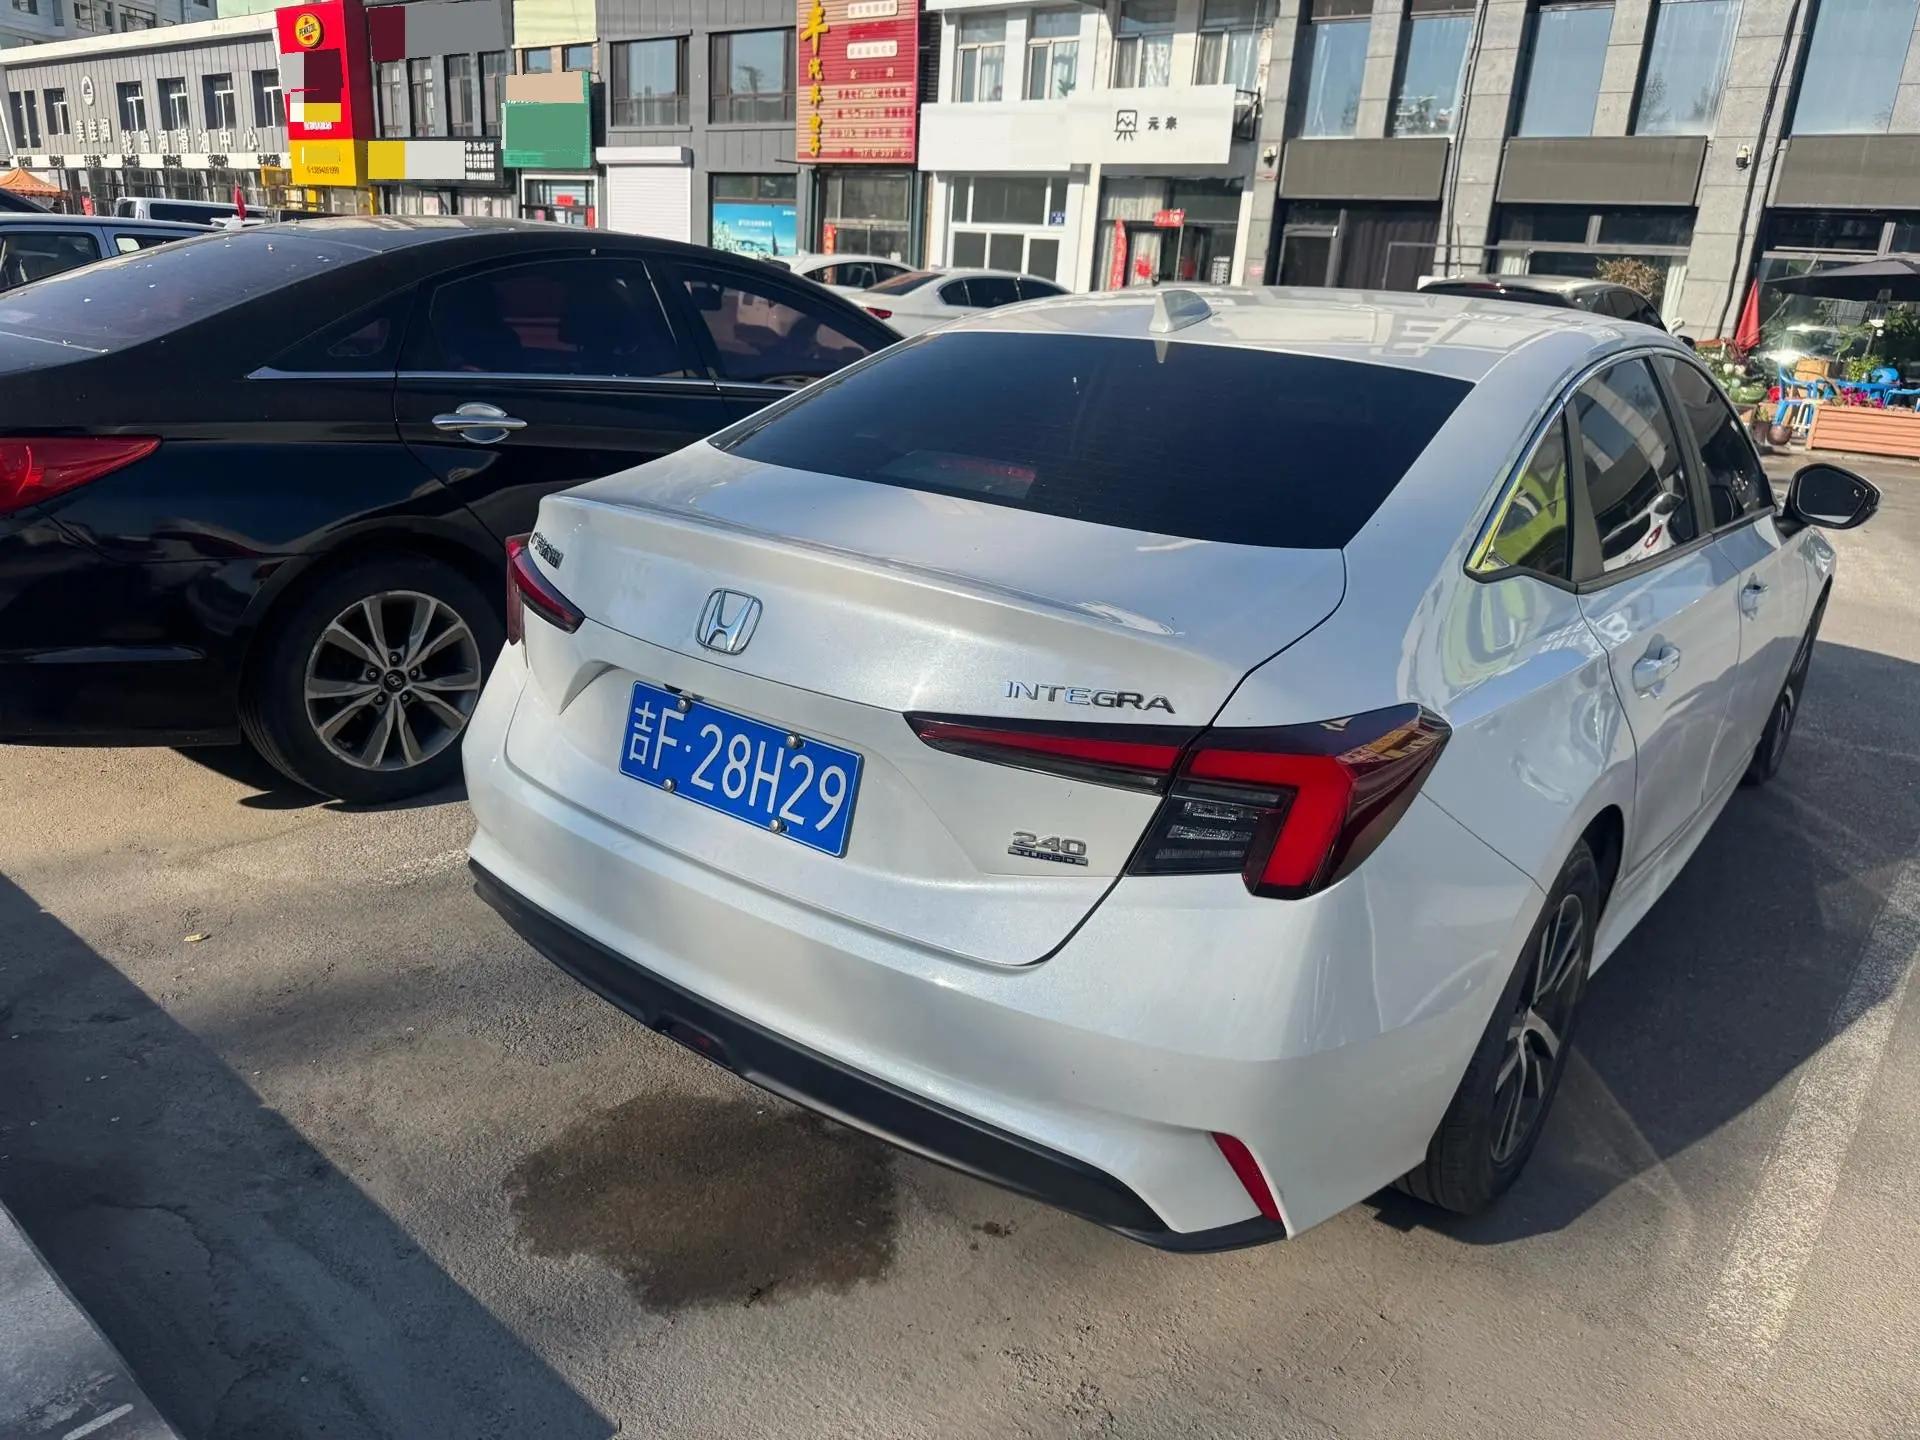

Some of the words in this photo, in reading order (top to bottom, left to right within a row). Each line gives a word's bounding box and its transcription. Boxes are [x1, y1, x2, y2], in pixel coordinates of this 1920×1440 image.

[1004, 680, 1176, 714] INTEGRA
[628, 701, 847, 832] 吉F·28H29
[1012, 831, 1086, 856] 240
[1012, 847, 1080, 865] TURBO
